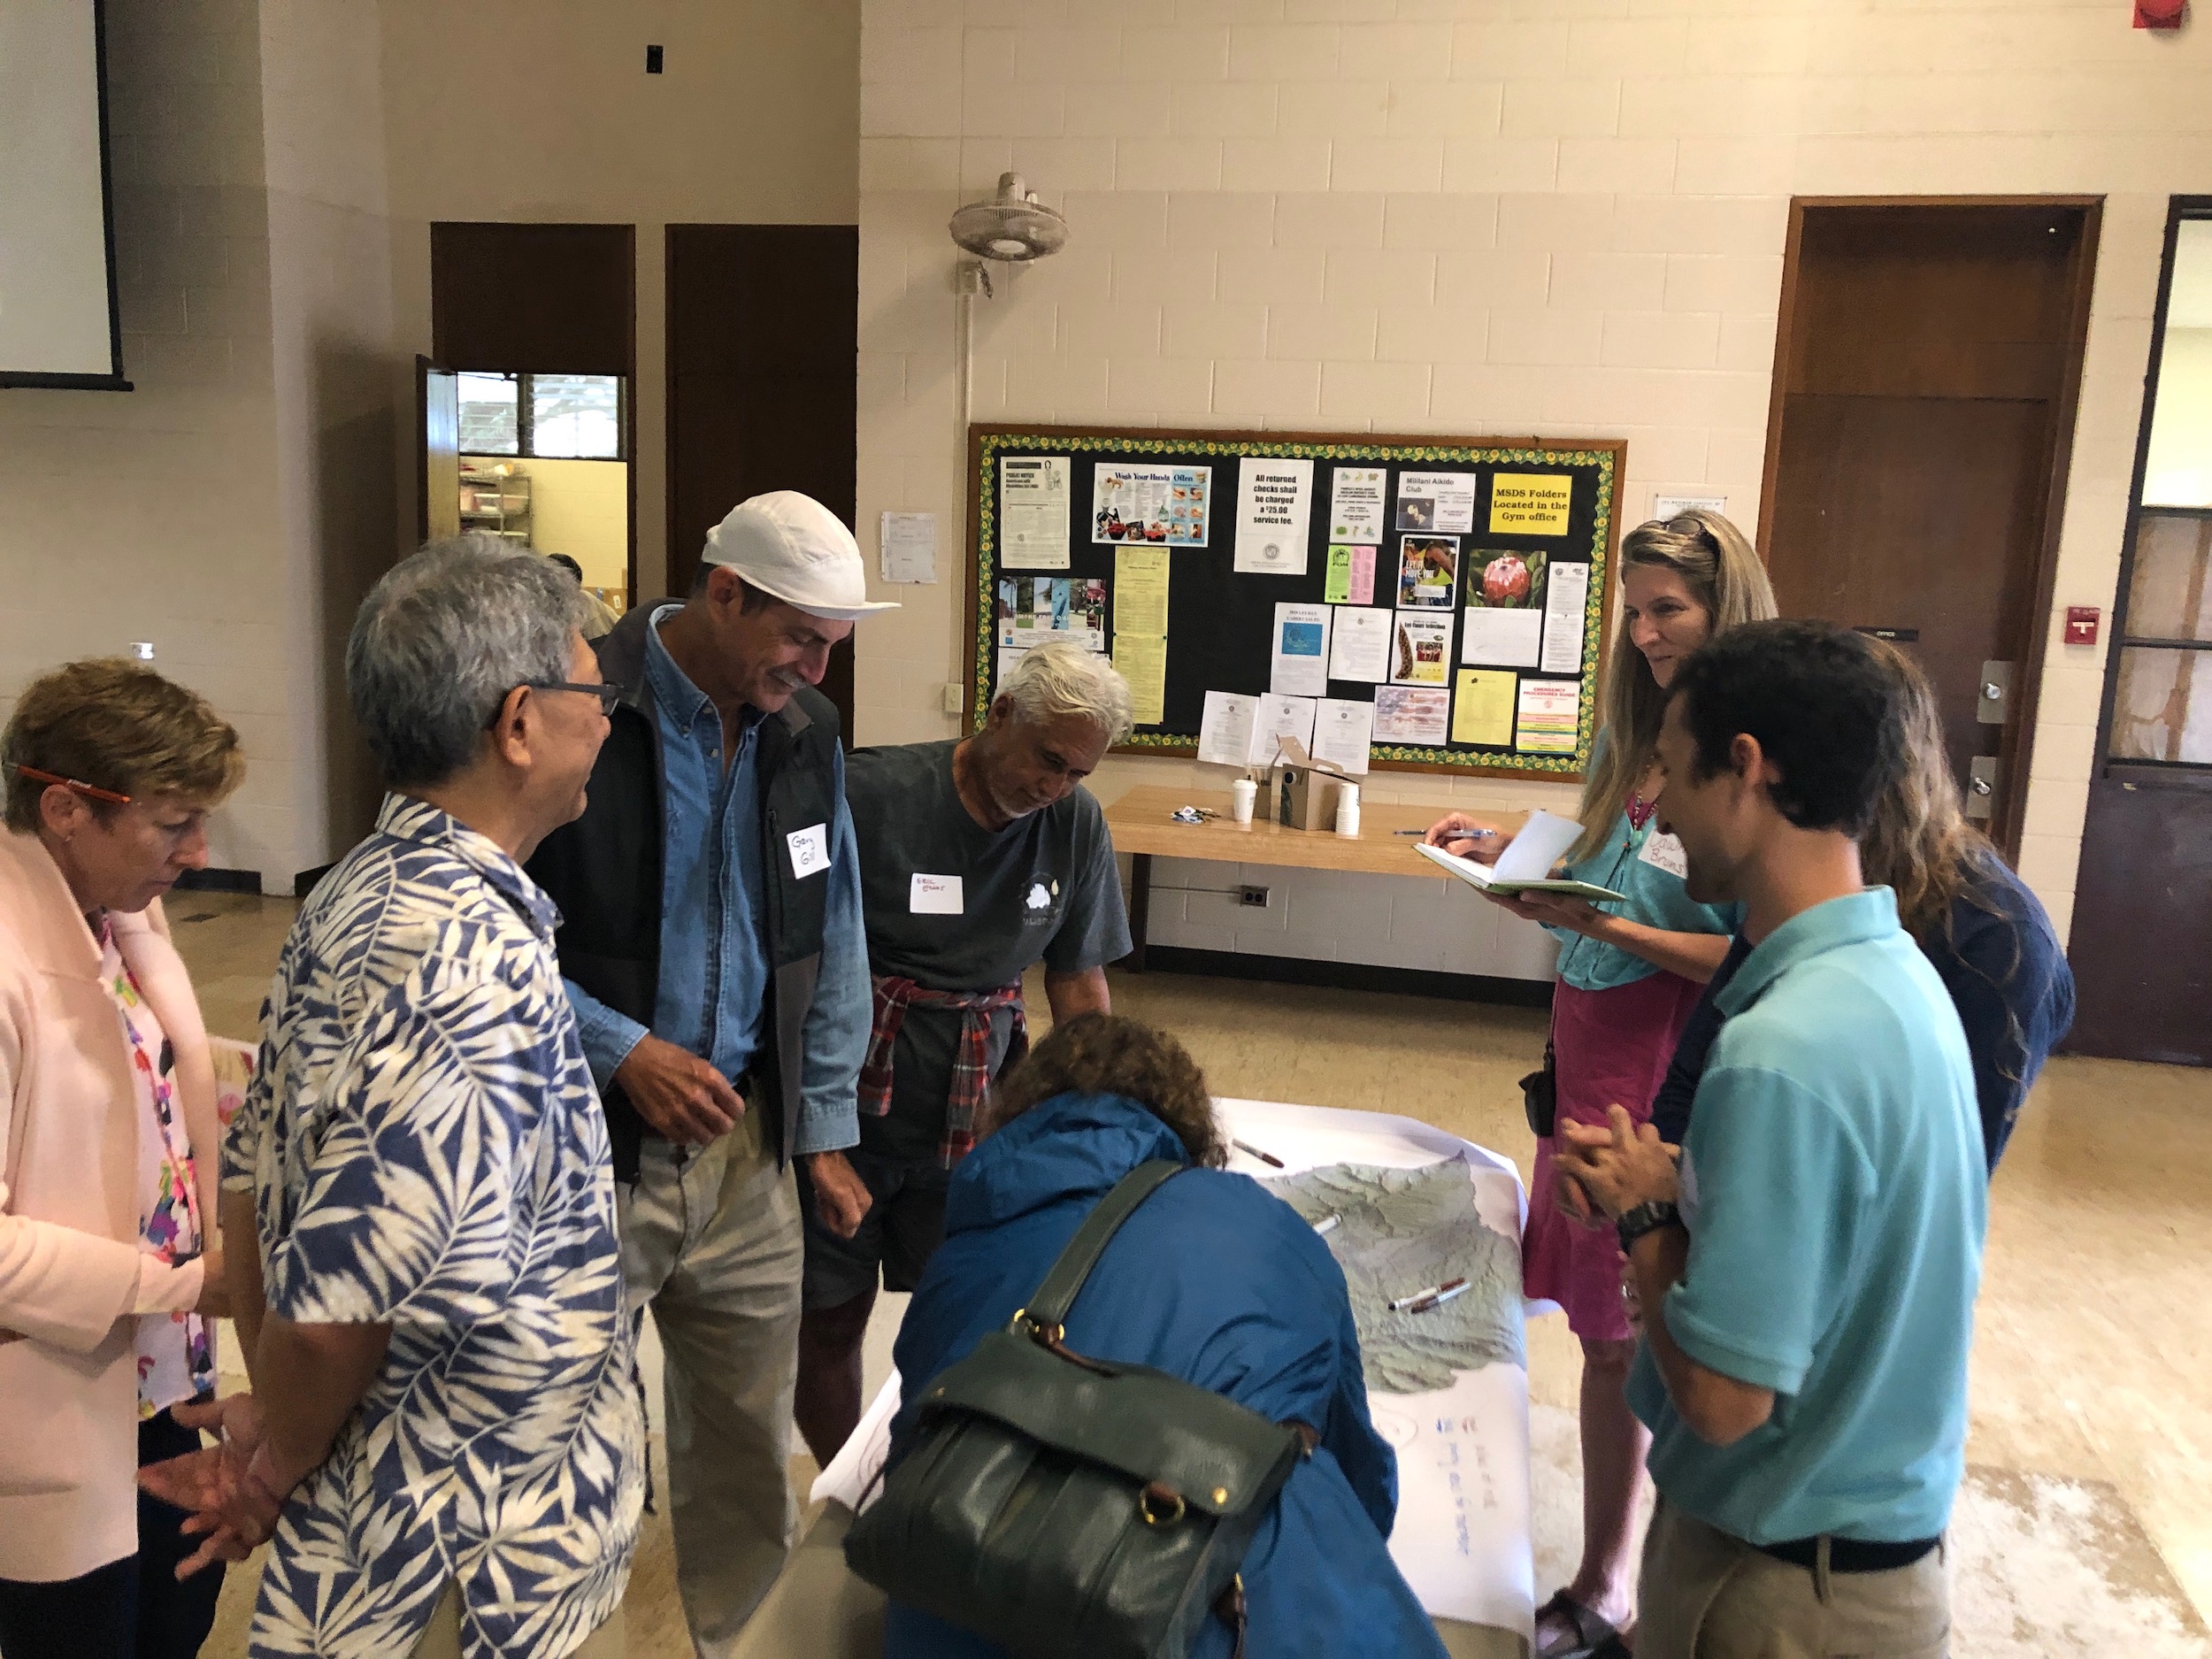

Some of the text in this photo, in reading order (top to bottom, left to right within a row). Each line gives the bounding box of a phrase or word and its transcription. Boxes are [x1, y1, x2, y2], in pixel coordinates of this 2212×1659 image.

[1496, 488, 1567, 498] MSDS Folders
[1265, 495, 1294, 504] charged
[1502, 511, 1557, 522] Gym office
